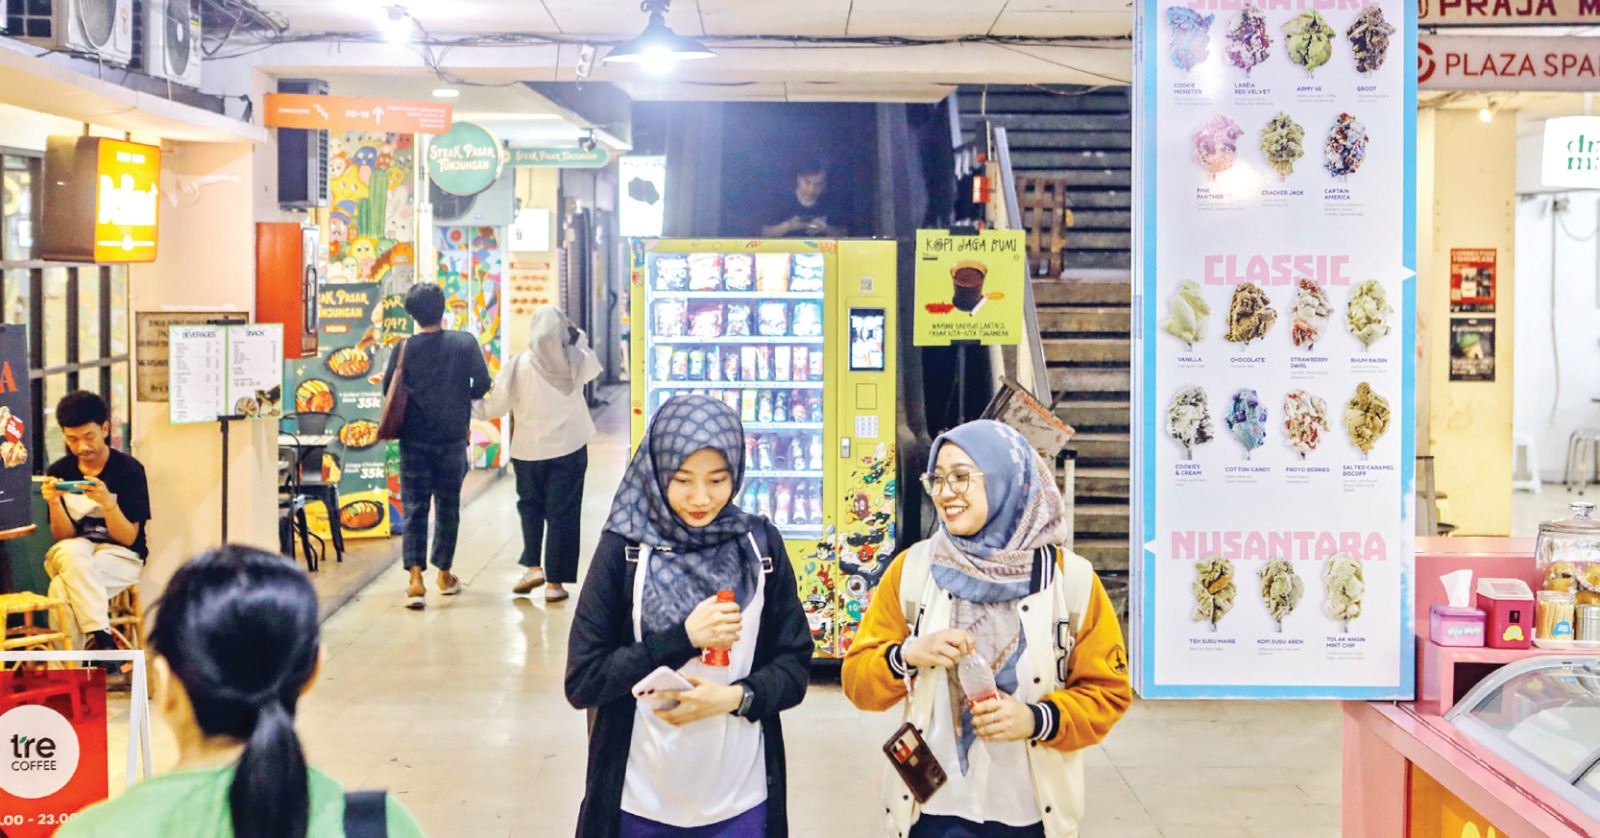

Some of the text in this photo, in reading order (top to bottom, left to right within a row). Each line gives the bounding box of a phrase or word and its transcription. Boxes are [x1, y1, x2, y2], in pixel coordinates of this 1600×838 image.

[1445, 53, 1600, 77] PLAZA SPA
[436, 158, 490, 173] TUNJUNGAN
[957, 238, 986, 252] JAGA
[991, 238, 1017, 252] BUMI
[1204, 254, 1350, 287] CLASSIC
[182, 330, 216, 338] BEVERAGES
[357, 397, 381, 409] 35k
[360, 467, 384, 479] 35k
[1170, 530, 1387, 561] NUSANTARA
[11, 760, 57, 771] COFFEE
